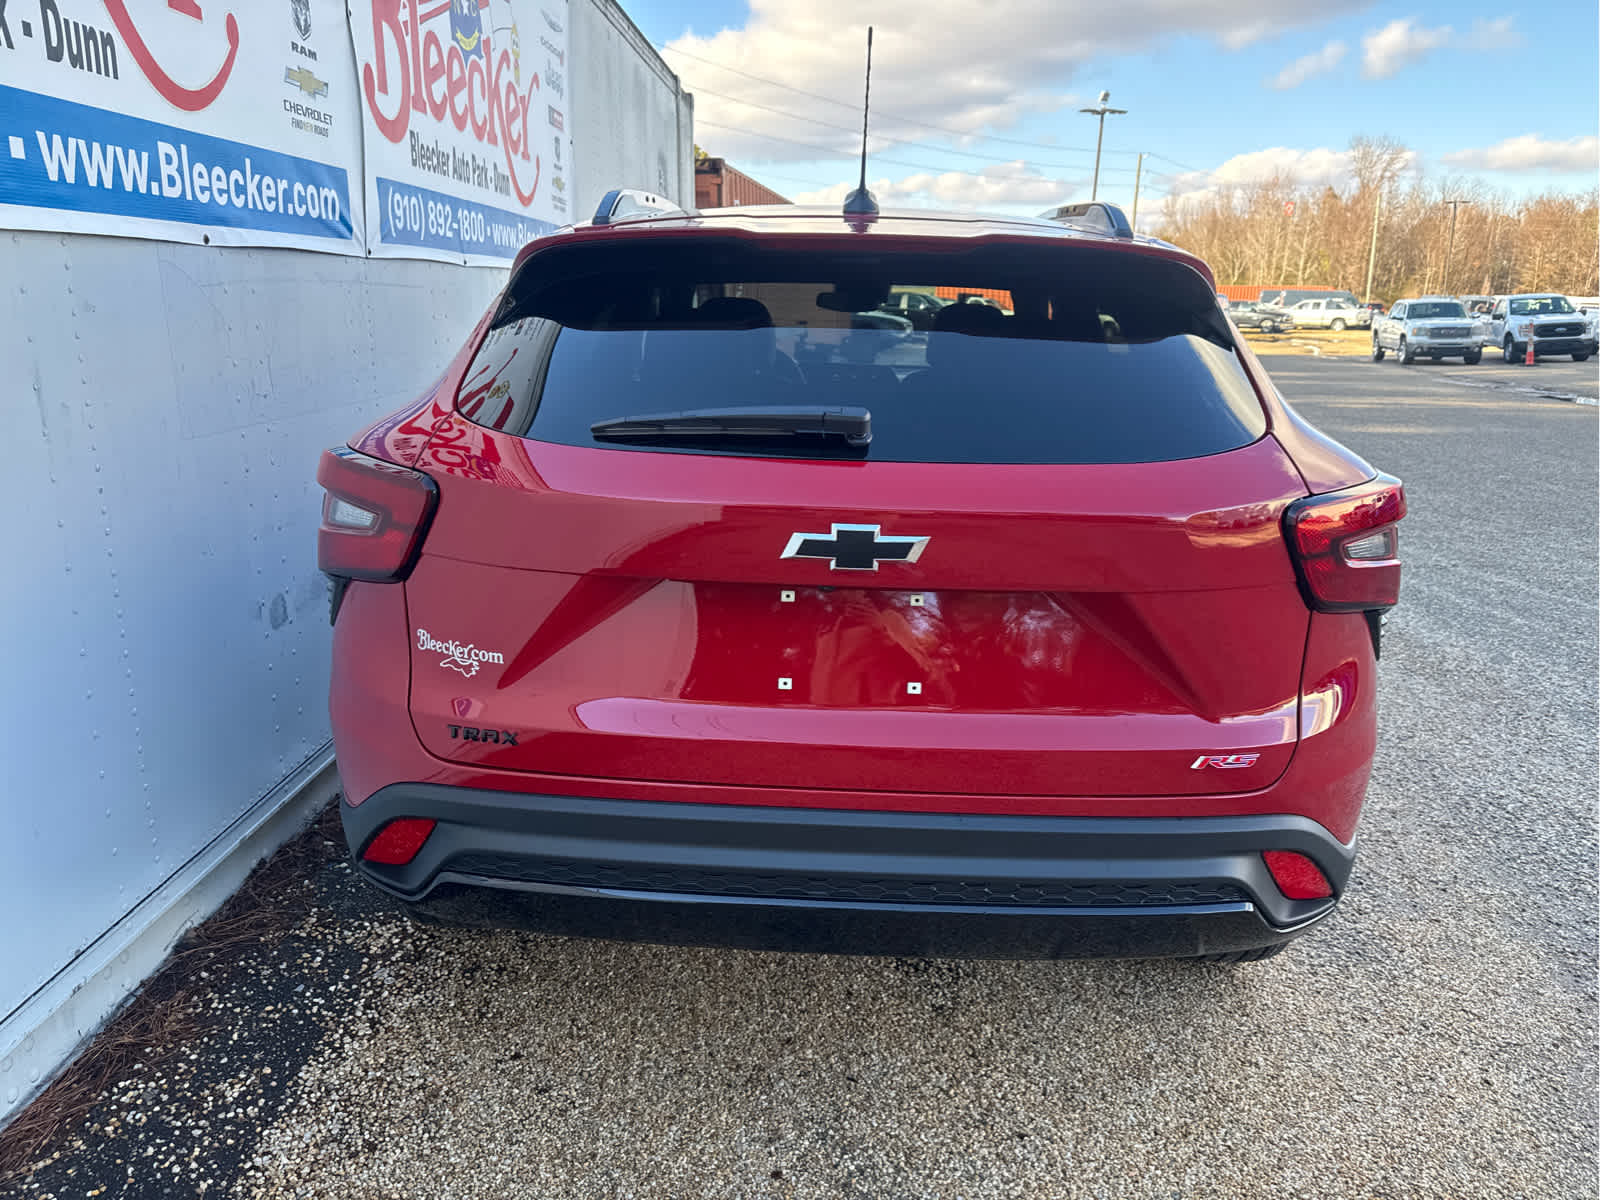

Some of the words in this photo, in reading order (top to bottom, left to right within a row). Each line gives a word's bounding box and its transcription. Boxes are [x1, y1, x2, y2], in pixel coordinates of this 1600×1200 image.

[40, 0, 119, 80] Dunn
[291, 41, 317, 61] RAM
[283, 99, 333, 126] CHEVROLET
[36, 130, 340, 222] www.Bleecker.com
[409, 130, 450, 177] Bleecker
[452, 145, 471, 184] Auto
[471, 152, 490, 191] Park
[493, 161, 511, 196] Dunn
[388, 187, 426, 241] (910)
[428, 200, 485, 243] 892-1800
[447, 724, 519, 746] TRAX
[1190, 753, 1261, 769] RS
